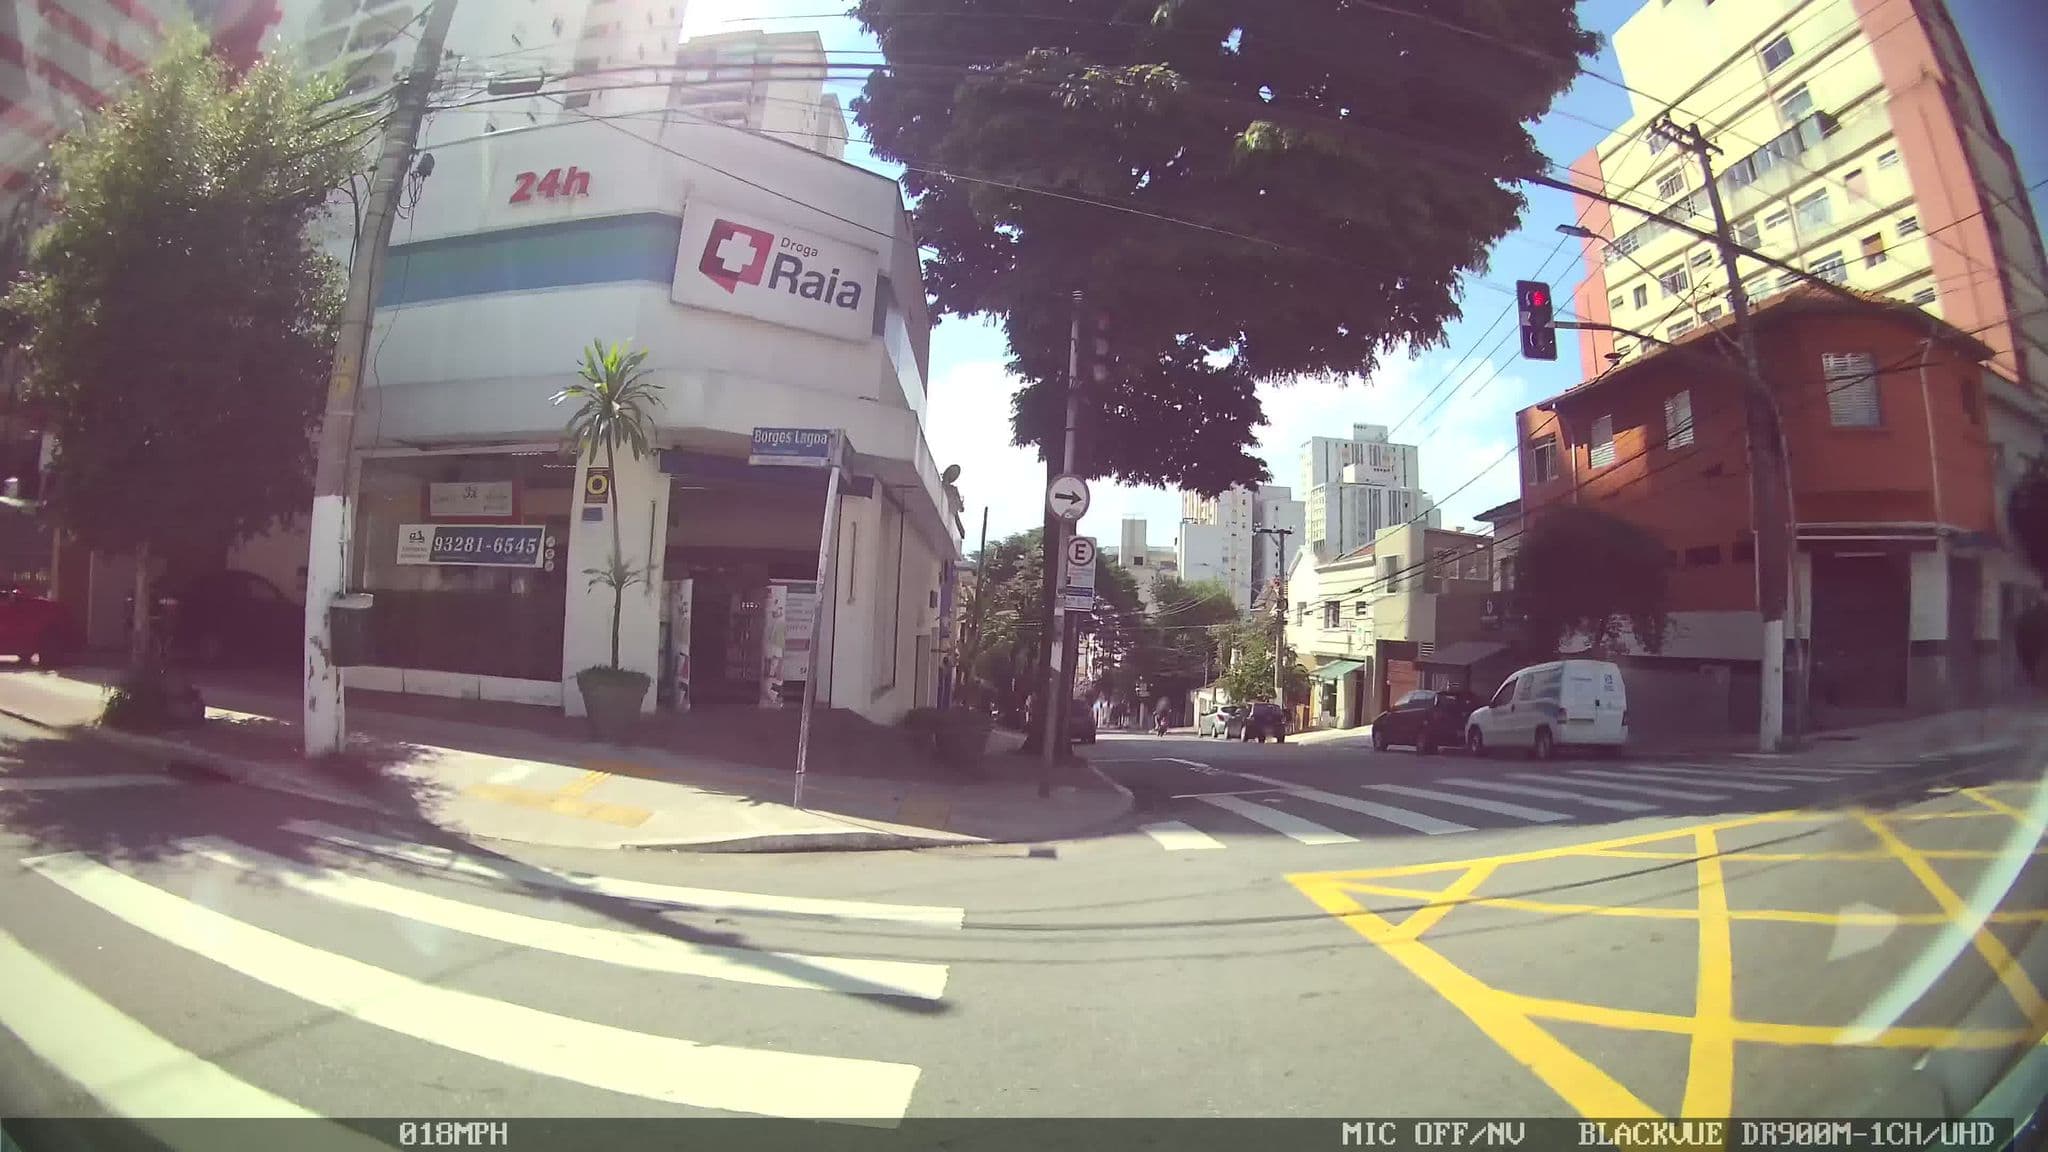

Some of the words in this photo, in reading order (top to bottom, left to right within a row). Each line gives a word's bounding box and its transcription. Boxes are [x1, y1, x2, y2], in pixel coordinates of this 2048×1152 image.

[509, 166, 591, 204] 24h
[780, 237, 819, 258] Droga
[767, 252, 862, 310] Raia
[754, 430, 791, 447] Borges
[795, 430, 828, 448] Lagoa
[433, 536, 537, 554] 93281-6545
[1074, 543, 1087, 560] E
